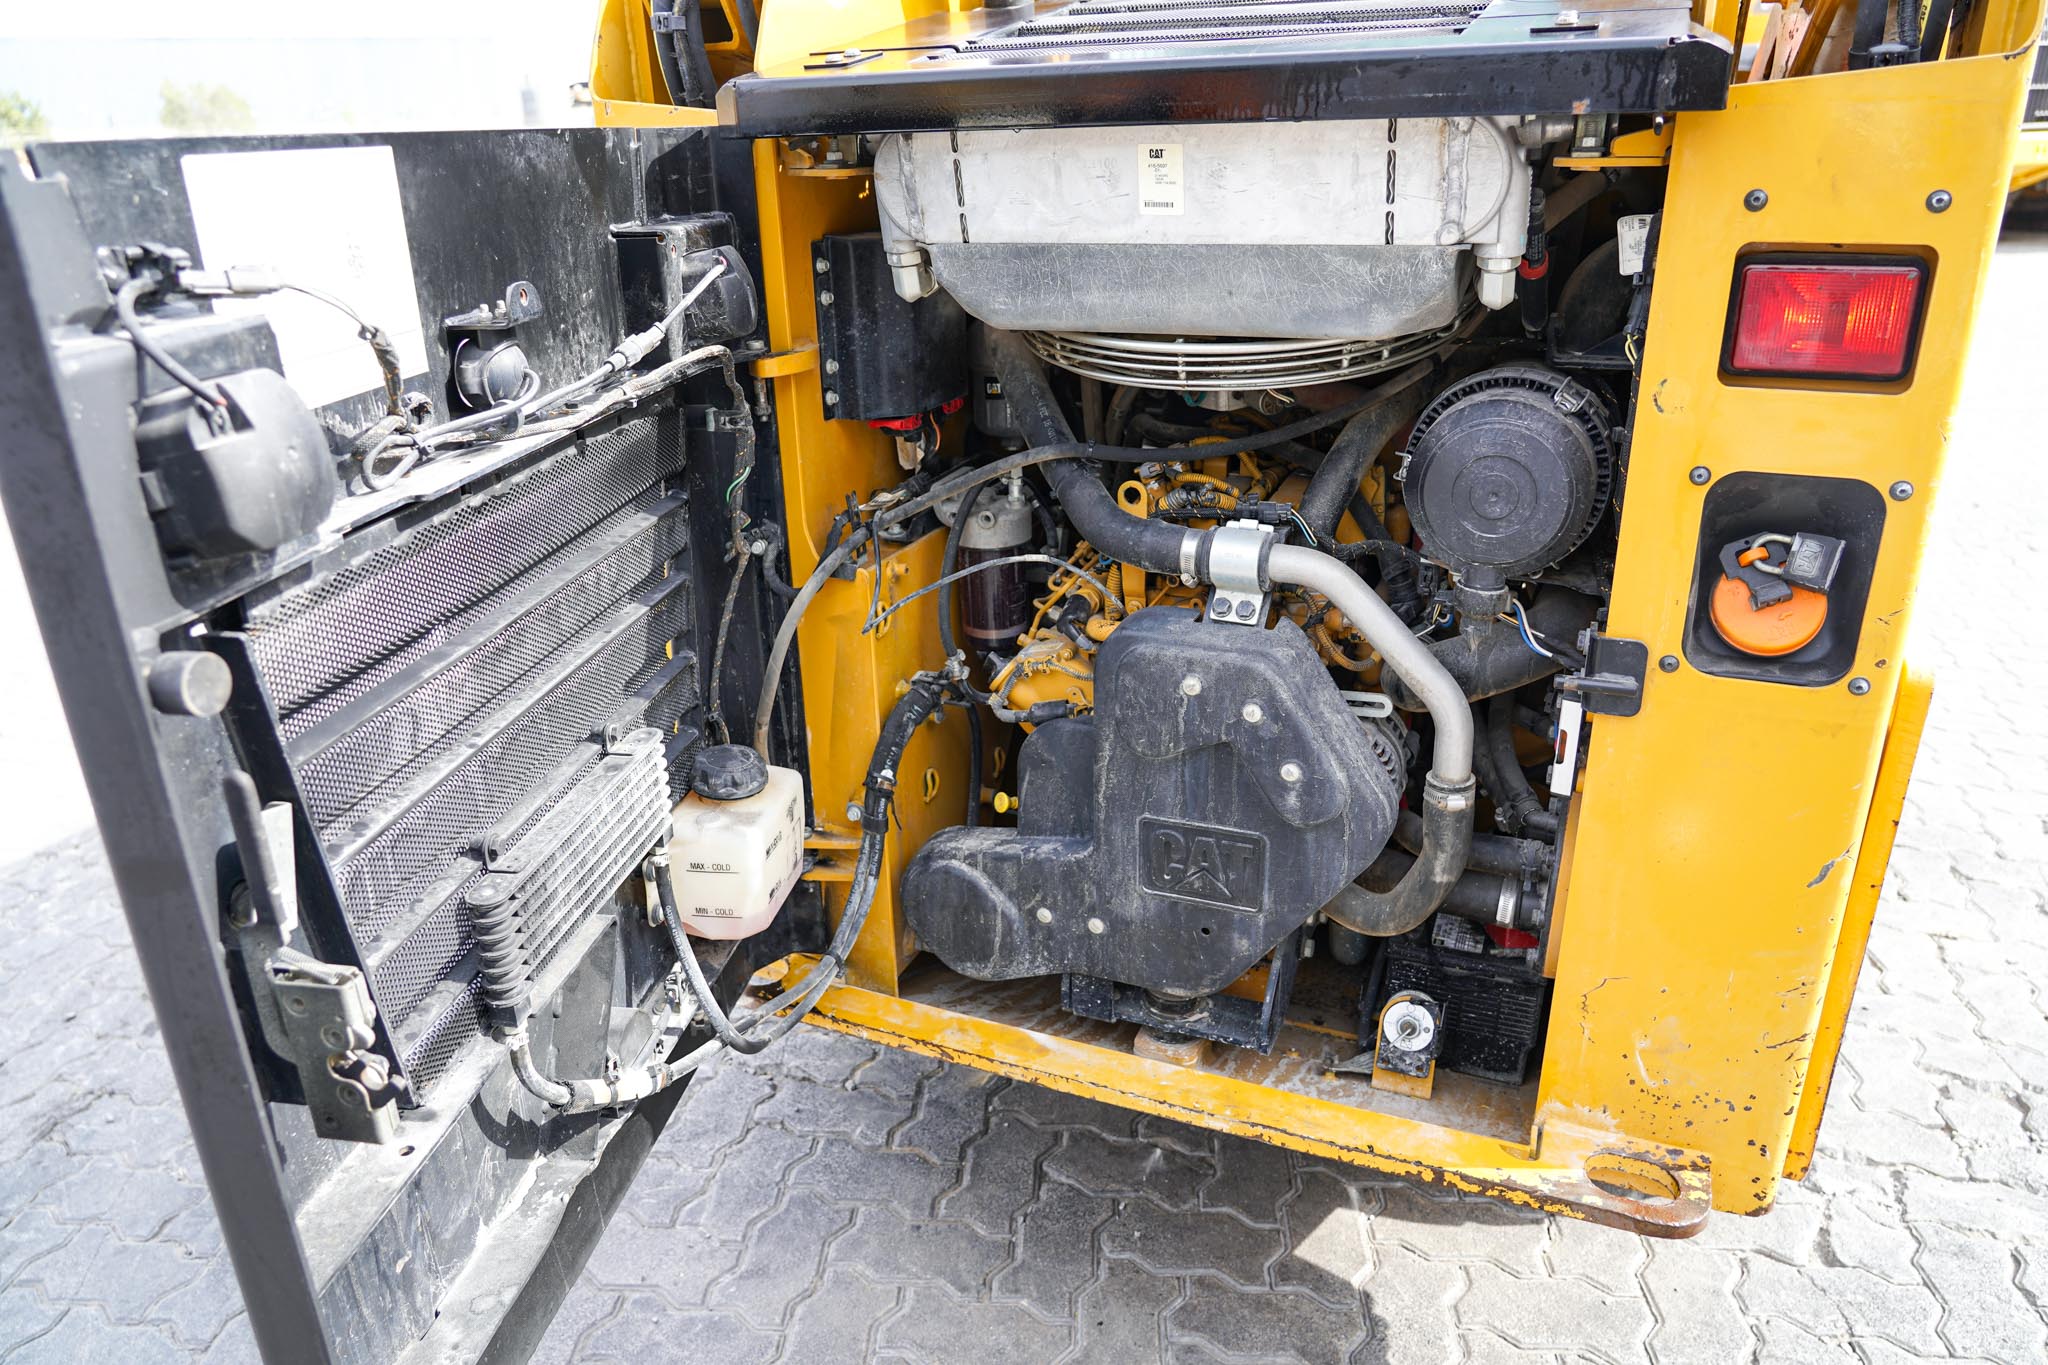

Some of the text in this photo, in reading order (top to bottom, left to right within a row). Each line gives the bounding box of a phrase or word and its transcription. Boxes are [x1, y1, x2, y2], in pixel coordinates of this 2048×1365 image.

[1149, 149, 1164, 158] CAT
[986, 383, 1001, 394] CAT
[690, 862, 705, 870] MAX
[712, 863, 731, 871] COLD
[1151, 829, 1255, 905] CAT
[695, 907, 708, 915] MIN
[715, 907, 733, 916] COLD
